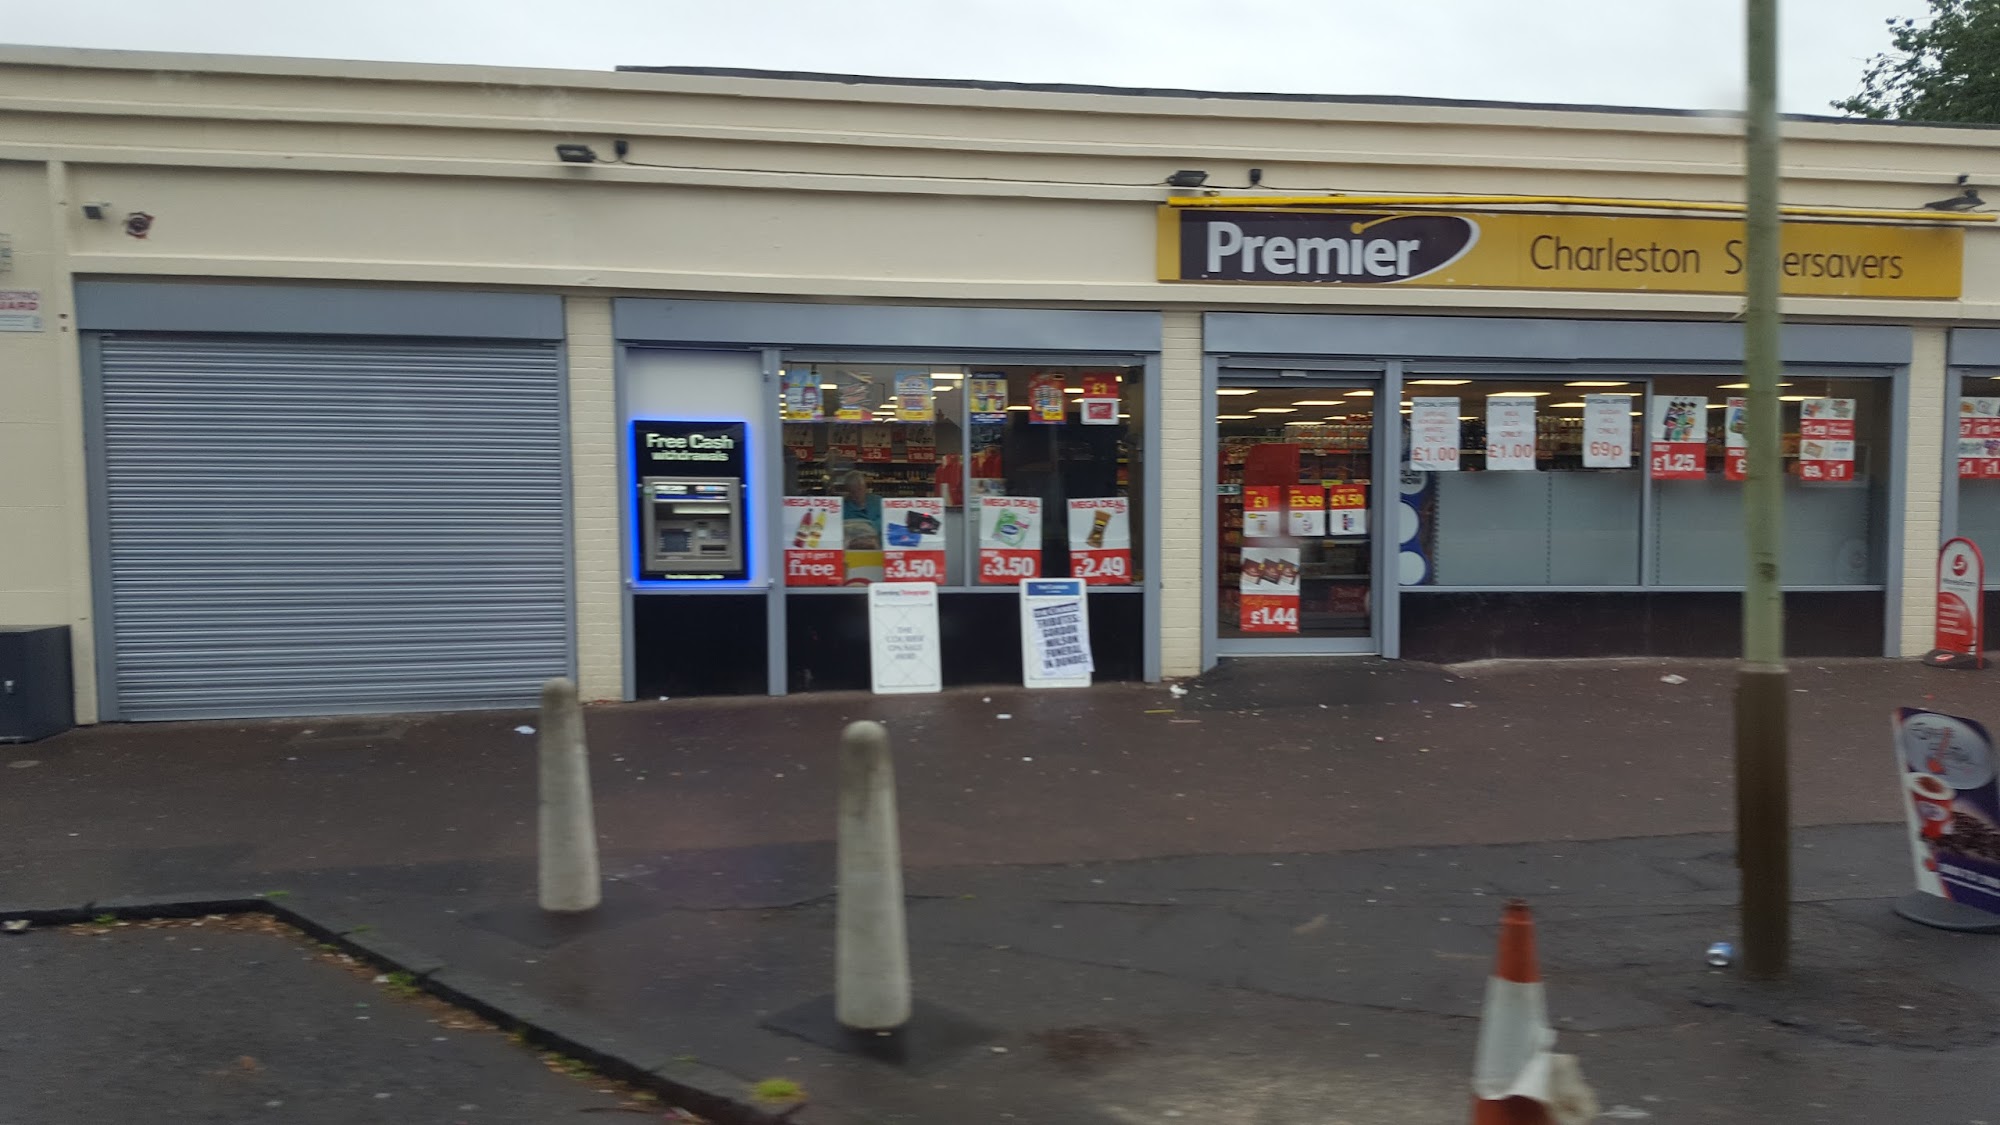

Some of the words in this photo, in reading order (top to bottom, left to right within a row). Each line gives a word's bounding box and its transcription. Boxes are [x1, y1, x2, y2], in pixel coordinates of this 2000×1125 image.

[1207, 221, 1420, 277] Premier
[1531, 235, 1700, 274] Charleston
[1724, 239, 1903, 280] Sersavers
[645, 433, 688, 449] Free
[689, 434, 735, 450] Cash
[1413, 447, 1457, 461] £1.00
[1488, 444, 1532, 458] £1.00
[1590, 441, 1623, 460] 69p
[1653, 453, 1696, 472] £1.25
[783, 498, 811, 508] MEGA
[884, 500, 914, 509] MEGA
[982, 498, 1012, 508] MEGA
[1071, 500, 1099, 510] MEGA
[1253, 496, 1270, 508] £1
[1290, 495, 1324, 507] £5.99
[788, 558, 836, 576] free
[885, 559, 936, 578] £3.50
[983, 556, 1035, 577] £3.50
[1074, 556, 1126, 578] £2.49
[1250, 606, 1297, 625] £1.44
